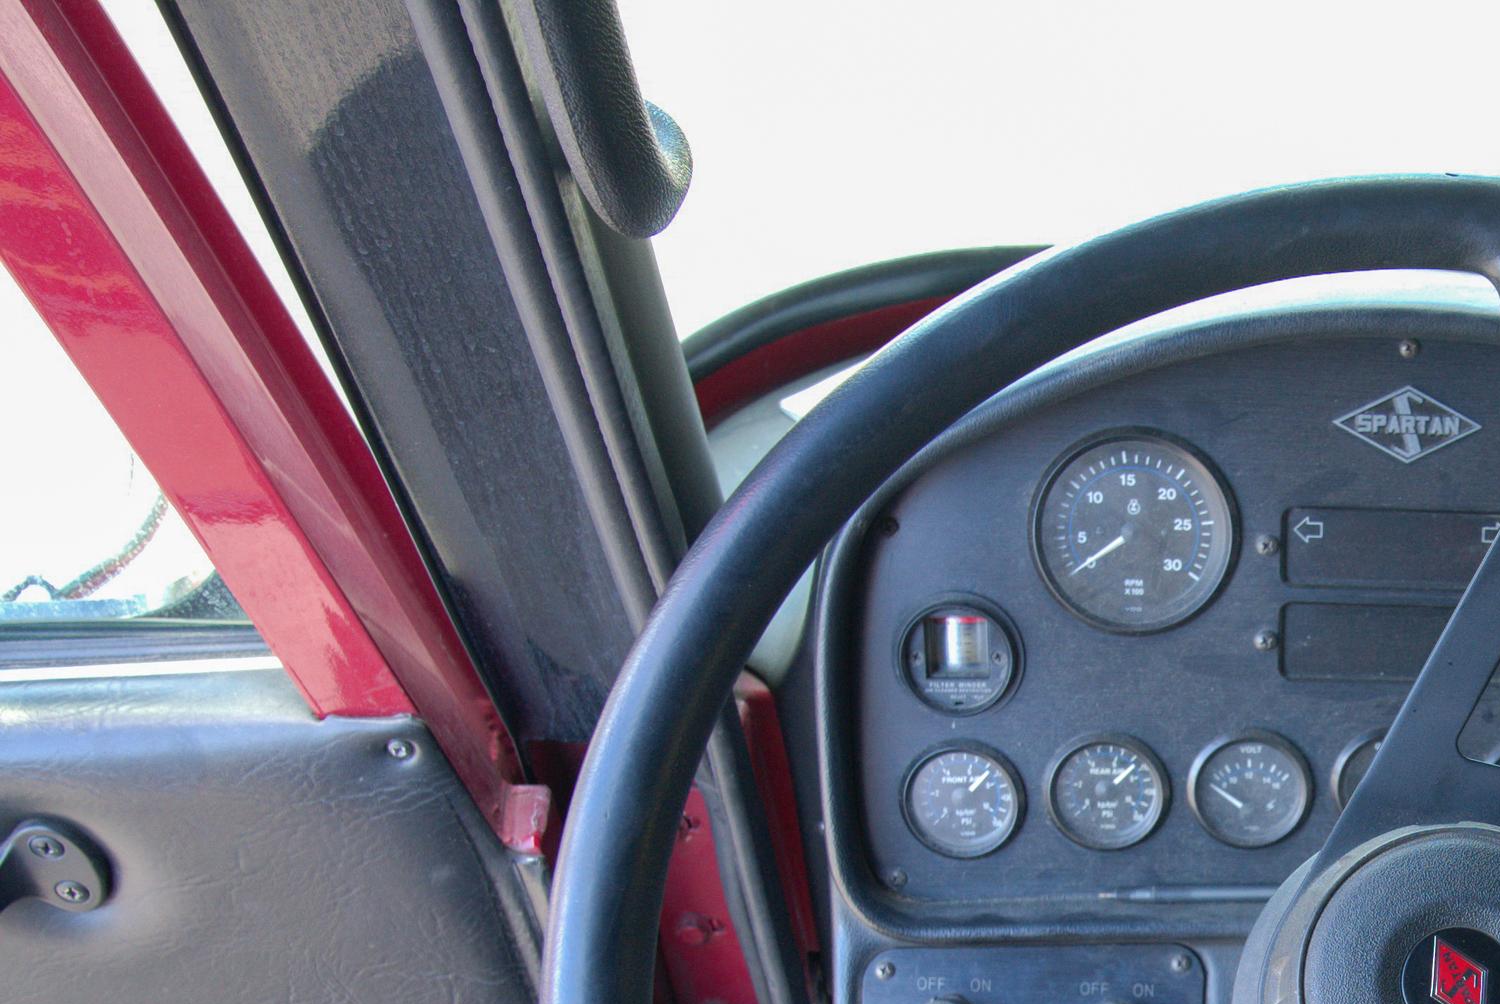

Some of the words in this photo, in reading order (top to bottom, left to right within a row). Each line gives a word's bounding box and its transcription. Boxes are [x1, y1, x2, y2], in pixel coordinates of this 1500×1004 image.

[1354, 413, 1460, 436] SPARTAN
[1120, 474, 1136, 486] 15
[1086, 492, 1103, 503] 10
[1158, 488, 1176, 500] 20
[1174, 519, 1192, 531] 25
[1078, 532, 1087, 543] 5
[1163, 559, 1182, 571] 30
[1124, 579, 1143, 587] RPM
[1240, 746, 1262, 754] VOLT
[942, 776, 967, 784] FRONT
[917, 977, 946, 990] OFF
[970, 979, 991, 992] ON
[1080, 982, 1109, 996] OFF
[1132, 984, 1154, 998] ON
